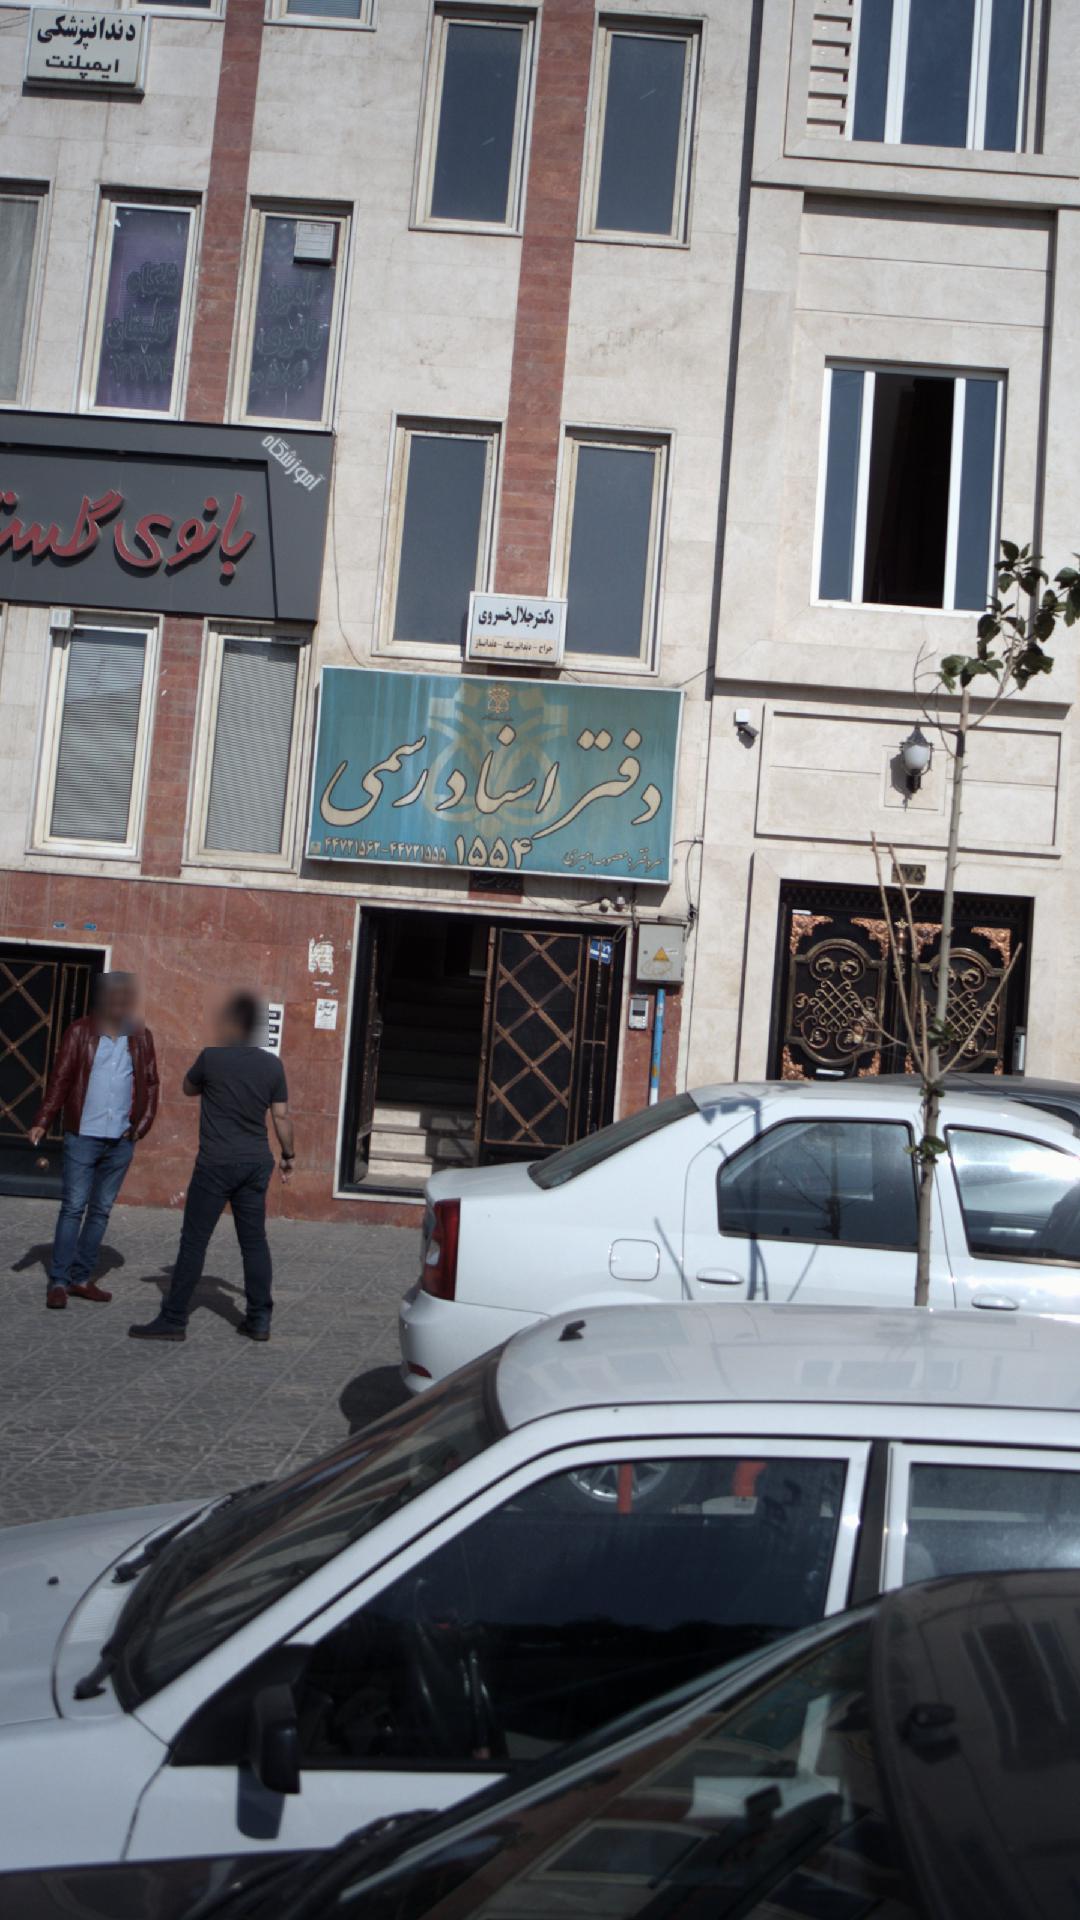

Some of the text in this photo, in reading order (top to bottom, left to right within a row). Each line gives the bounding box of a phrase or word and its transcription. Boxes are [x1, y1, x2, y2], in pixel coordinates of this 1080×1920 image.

[37, 14, 136, 50] دندانپزشکی
[45, 54, 119, 79] ایمپلنت
[261, 435, 326, 491] آموزشگاه
[114, 493, 252, 576] بانوی
[478, 604, 554, 629] دکتر جلال خسروی
[319, 724, 663, 840] دفتر اسناد رسمی
[454, 834, 534, 870] ۱۵۵۴
